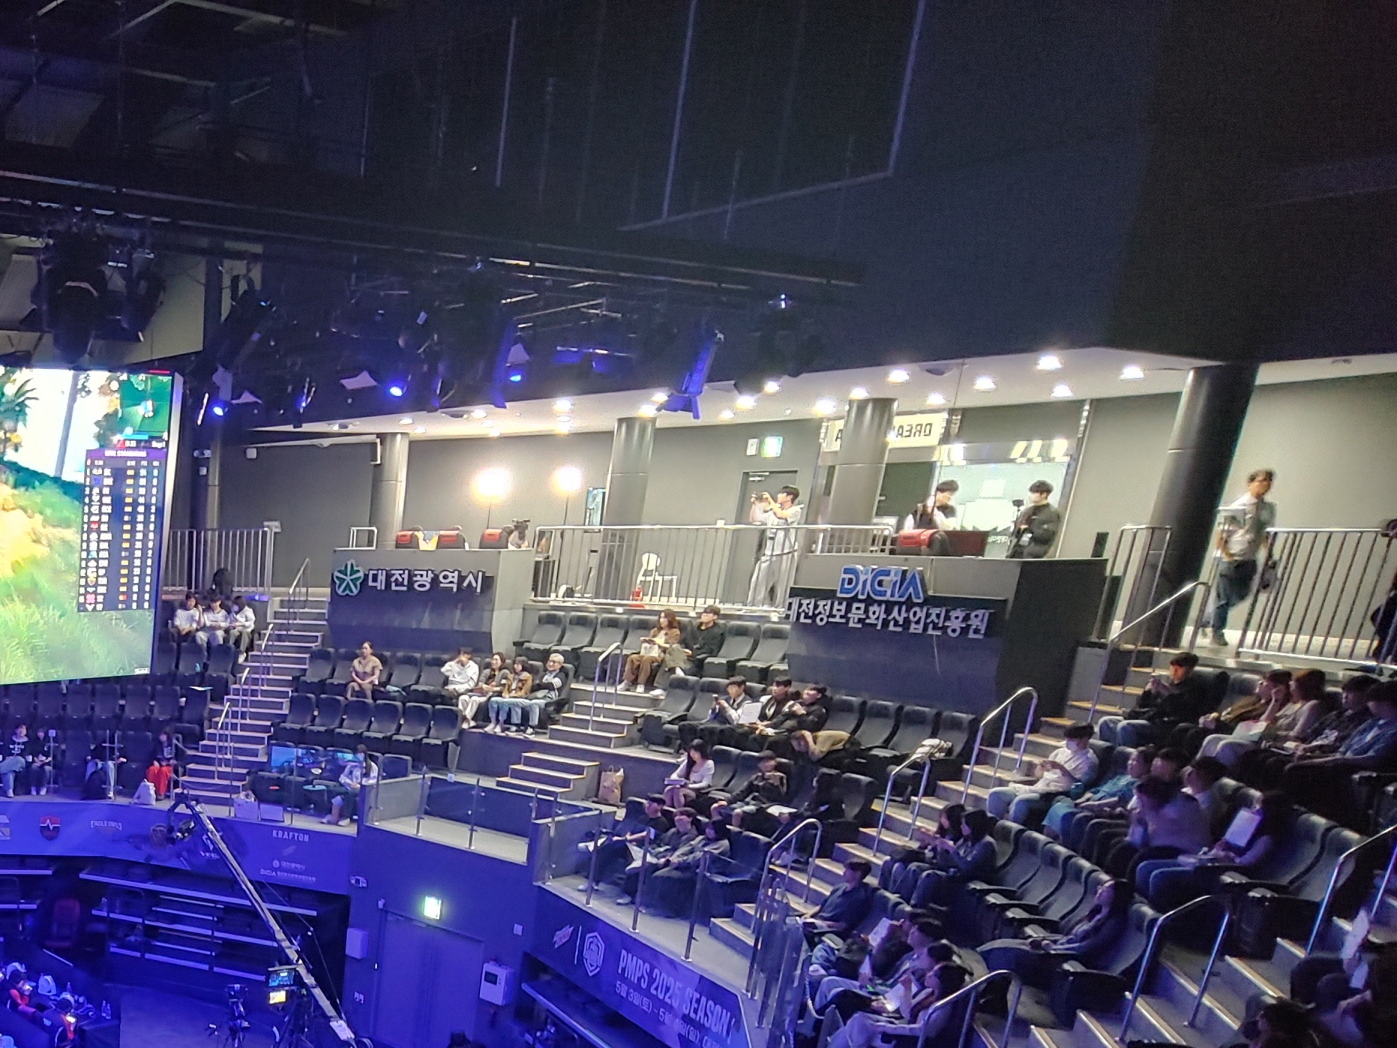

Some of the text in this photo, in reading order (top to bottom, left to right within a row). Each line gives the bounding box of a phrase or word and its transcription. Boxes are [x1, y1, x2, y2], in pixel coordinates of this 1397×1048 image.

[368, 569, 484, 594] 대전광역시
[785, 597, 989, 639] 대전정보문화산업진흥원
[272, 829, 309, 843] KRAFTON
[618, 949, 650, 990] PMPS
[650, 968, 683, 1014] 2025
[682, 987, 731, 1039] SEASON
